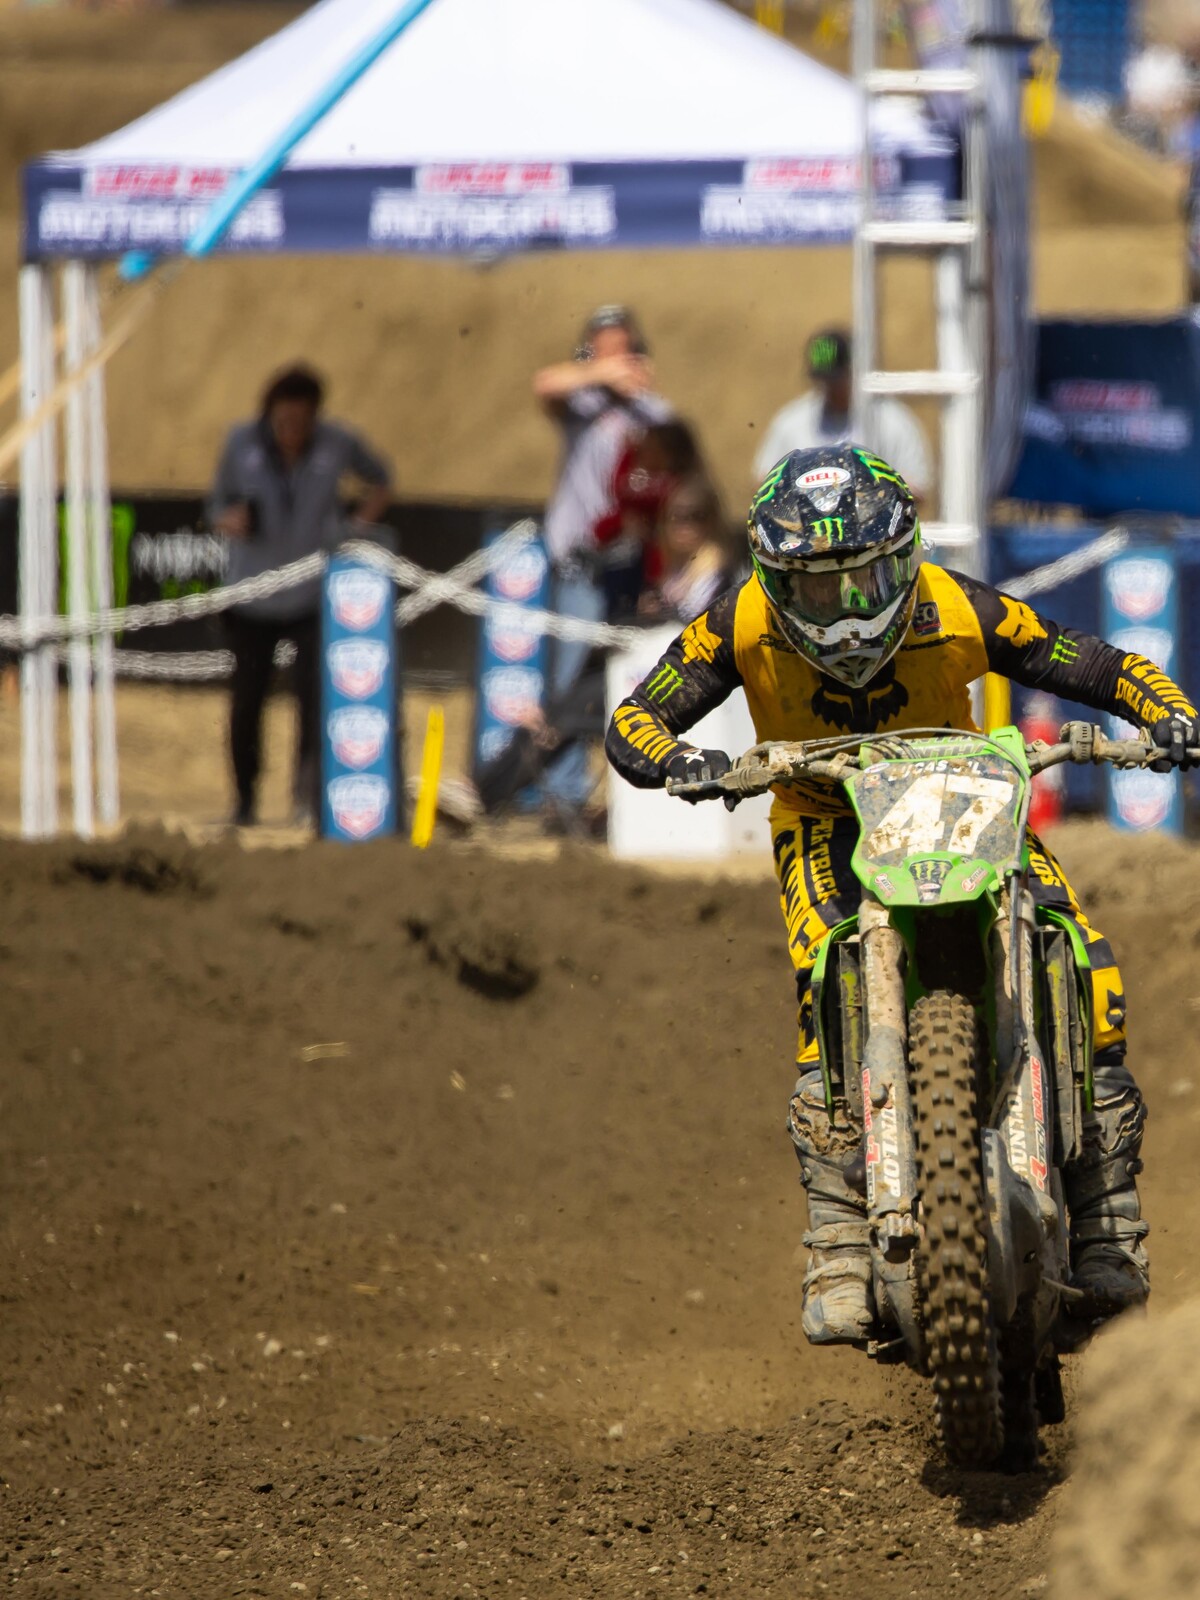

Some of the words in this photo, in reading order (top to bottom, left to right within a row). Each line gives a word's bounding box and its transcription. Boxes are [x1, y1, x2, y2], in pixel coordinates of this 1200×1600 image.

[805, 472, 839, 484] BELL
[868, 773, 1014, 859] 47
[1031, 1056, 1044, 1121] BRAKING
